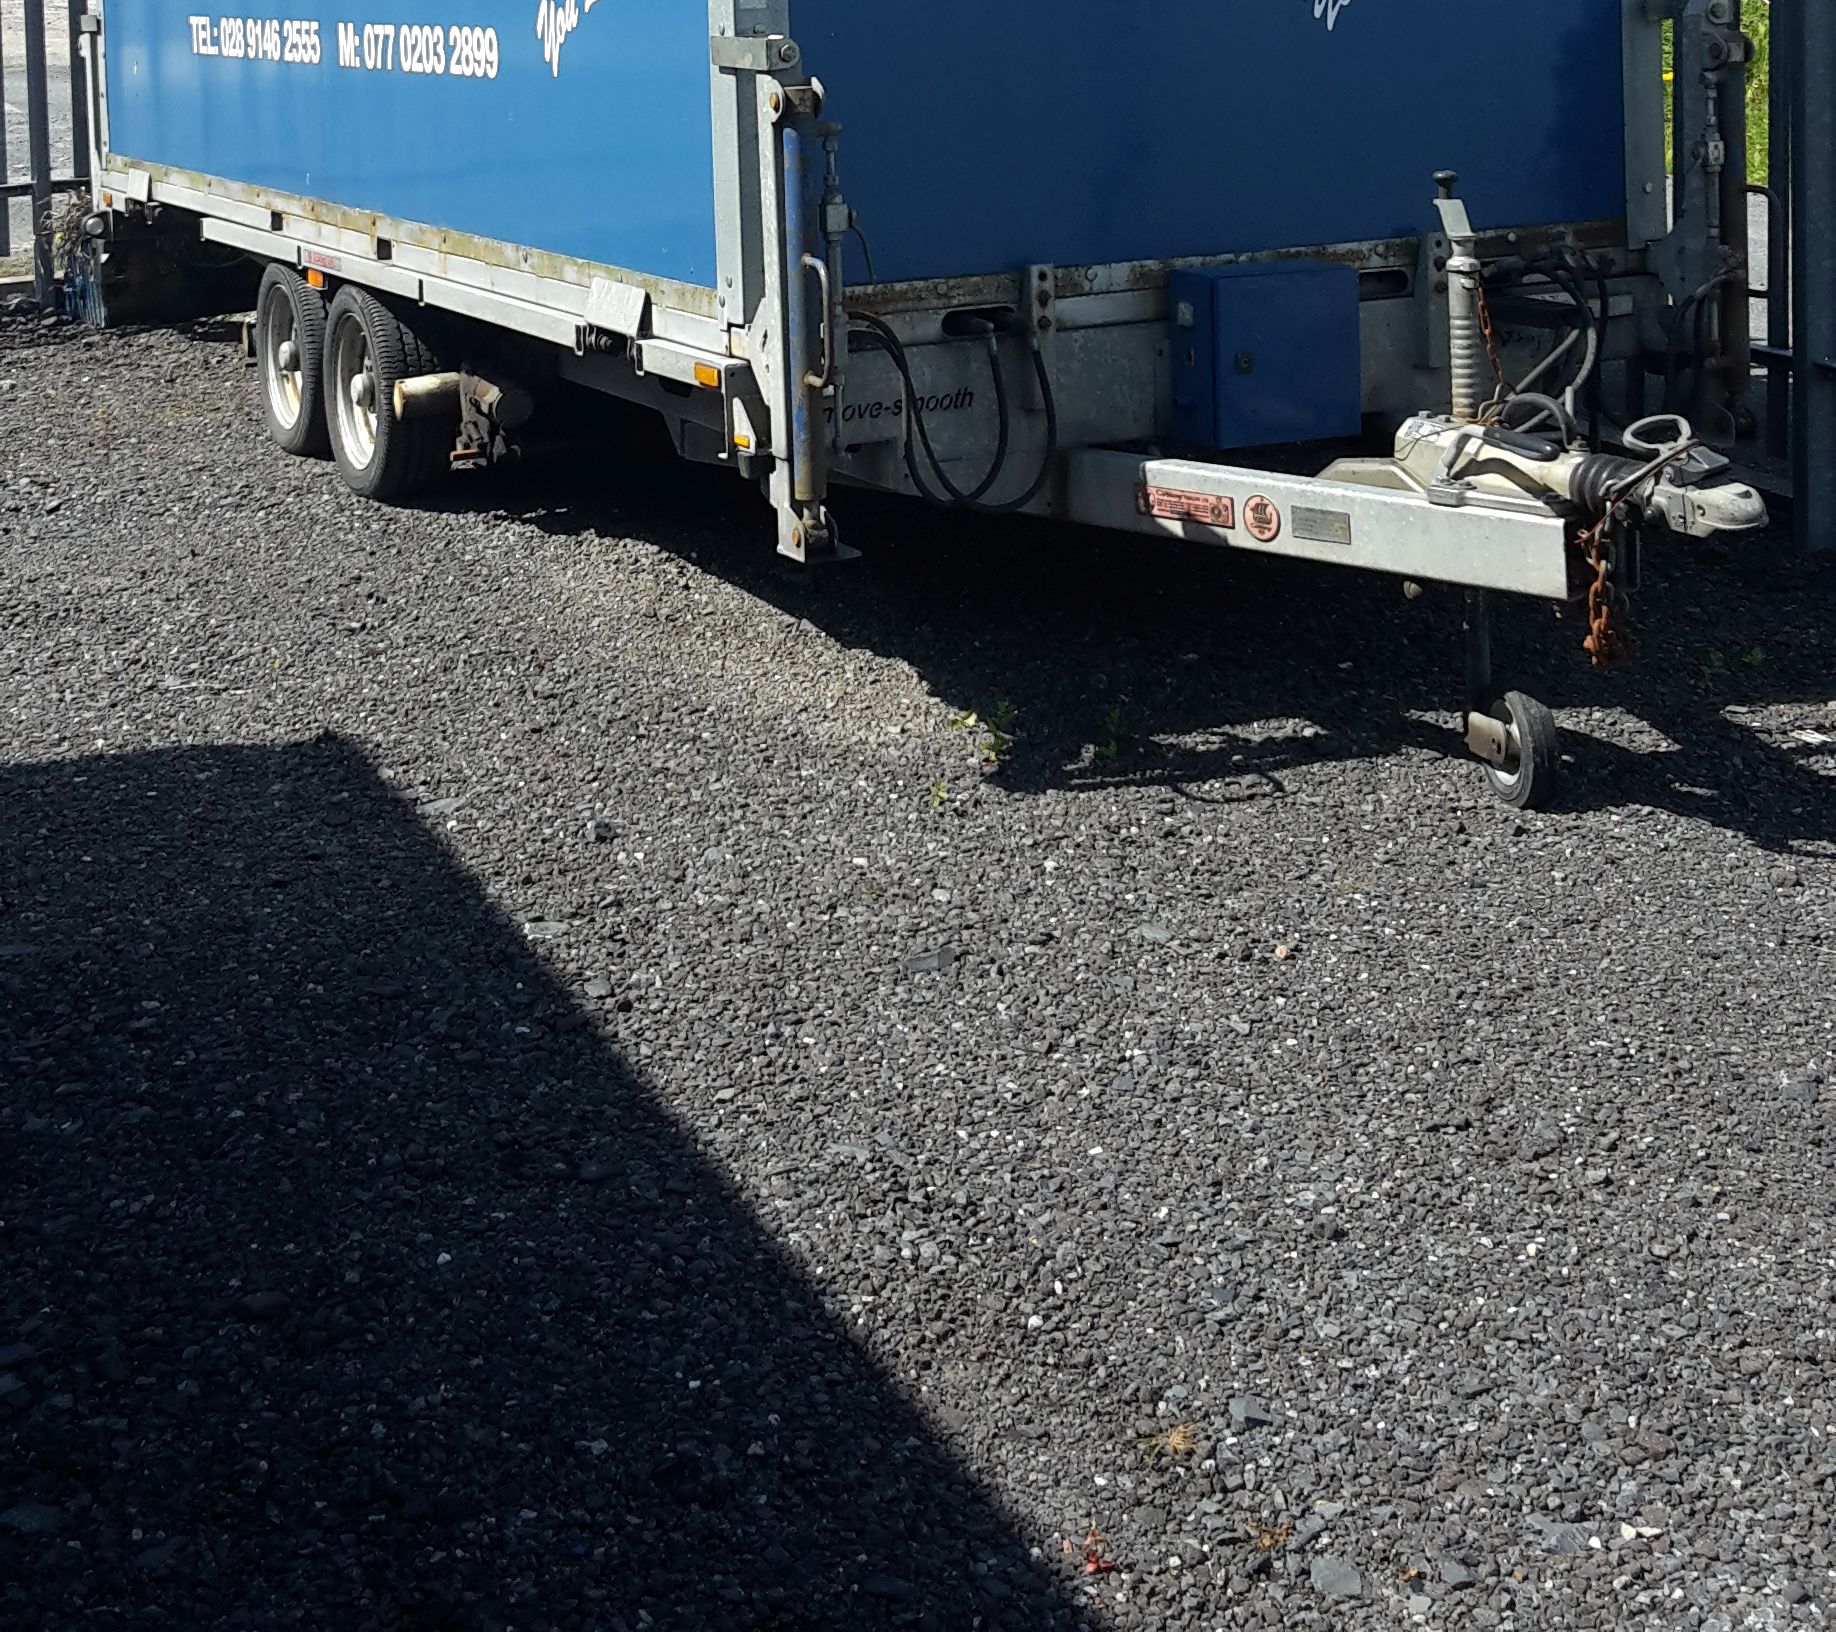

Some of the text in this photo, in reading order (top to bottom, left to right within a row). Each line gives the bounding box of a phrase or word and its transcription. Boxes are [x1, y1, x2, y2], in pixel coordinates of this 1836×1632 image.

[189, 15, 499, 79] TEL: 028 9146 2555 M: 077 0203 2899
